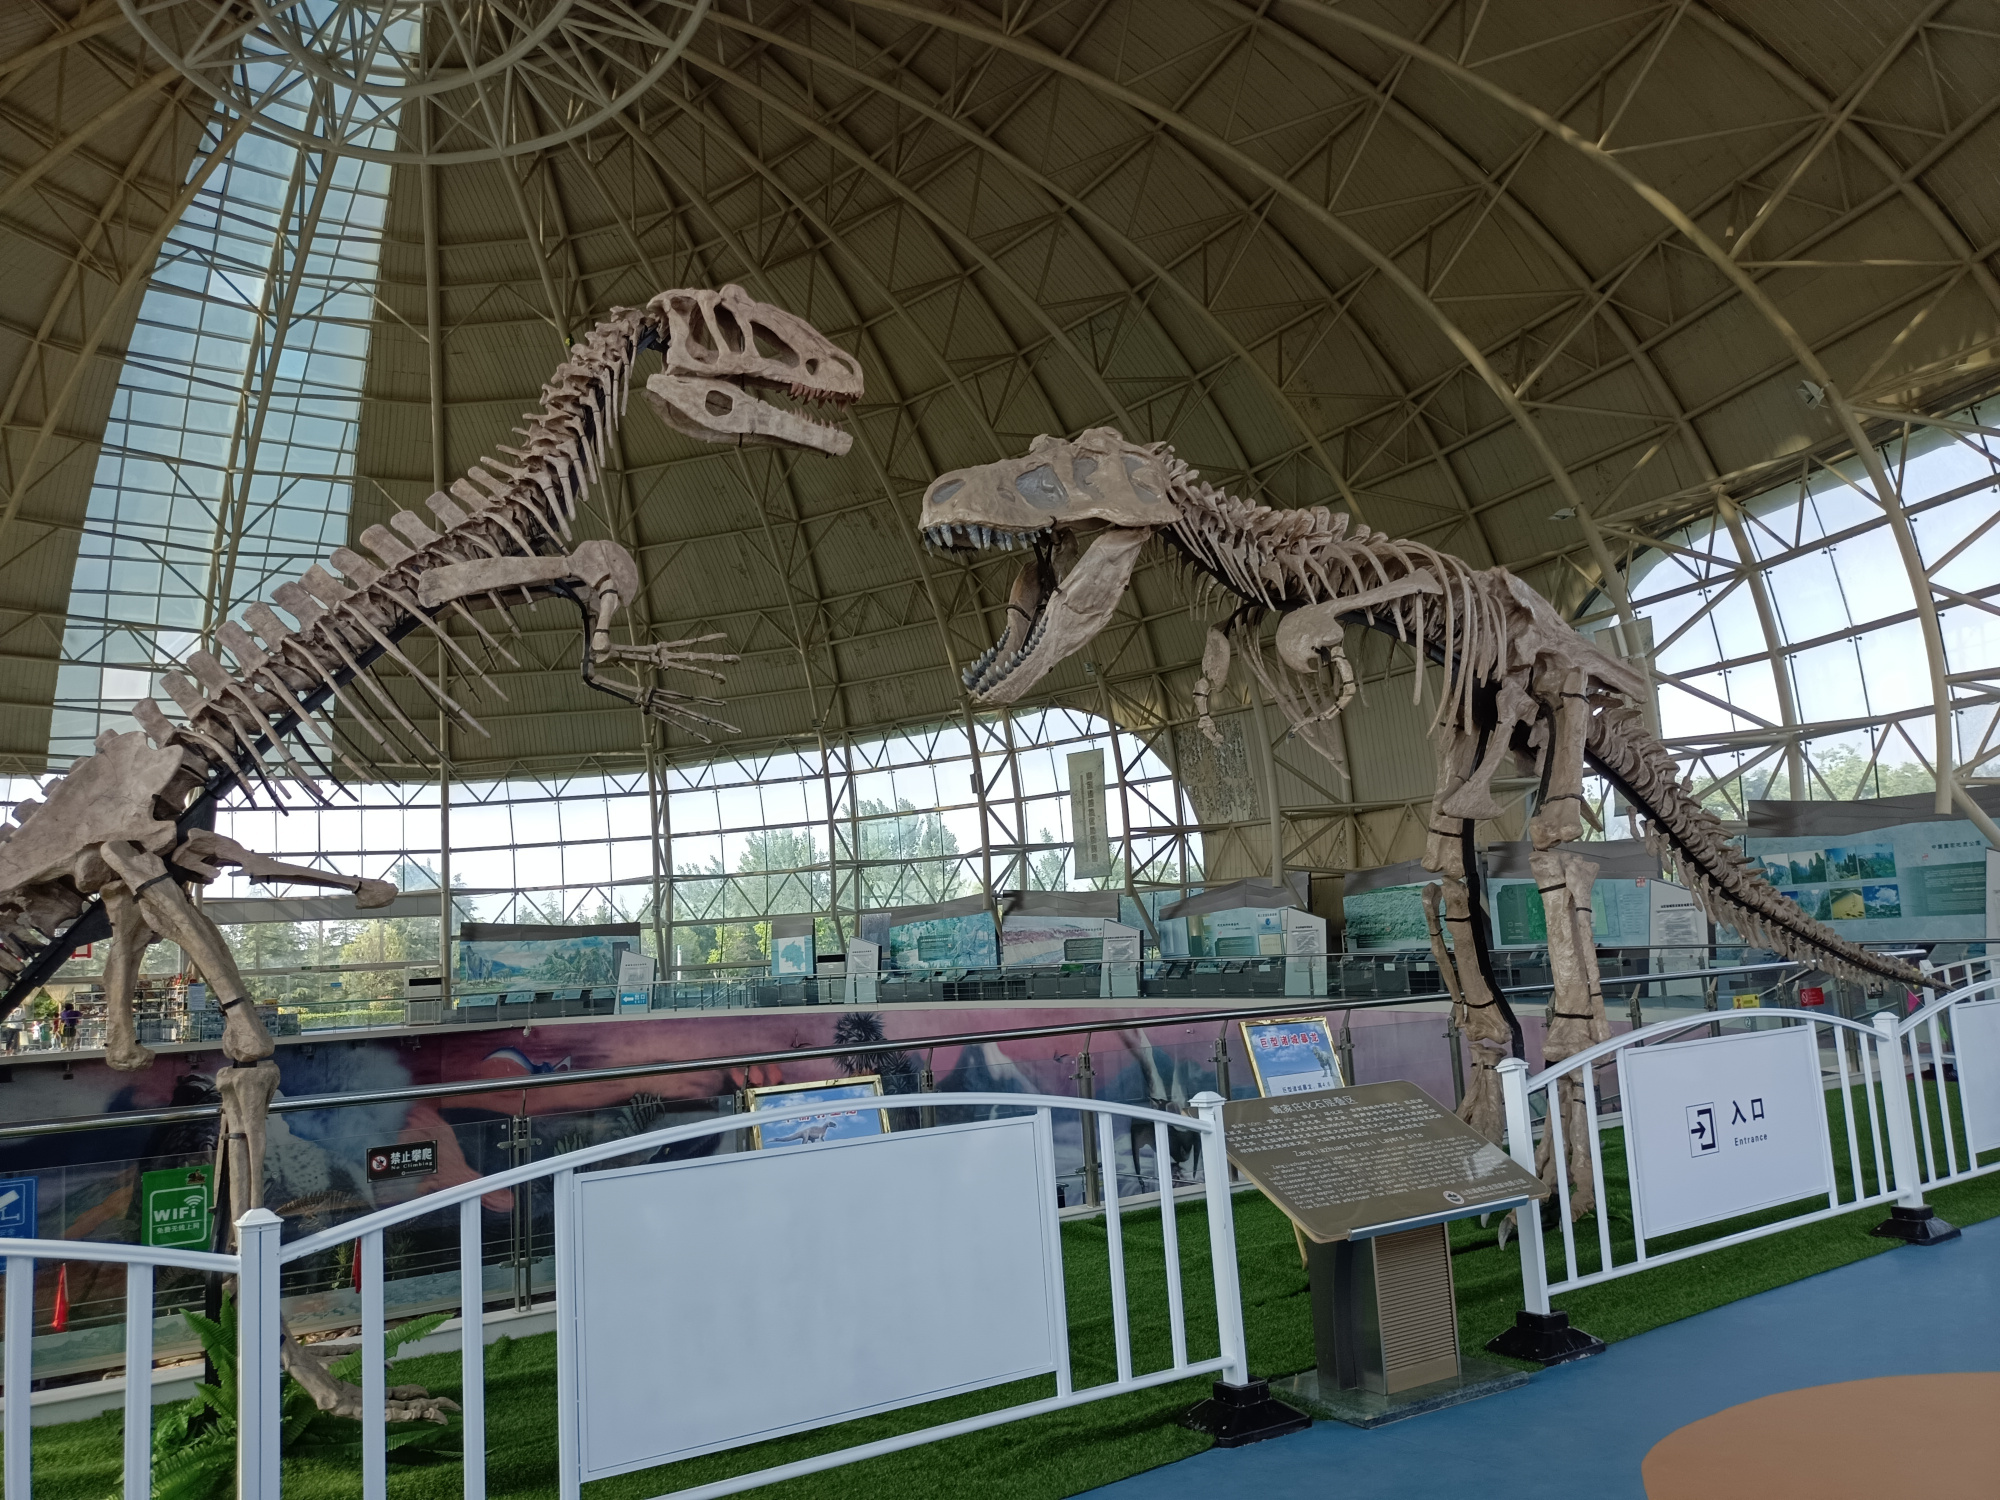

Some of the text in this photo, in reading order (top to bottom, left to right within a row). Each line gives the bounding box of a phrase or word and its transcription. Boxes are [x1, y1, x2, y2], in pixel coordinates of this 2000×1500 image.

[1260, 1032, 1319, 1048] 巨型诸城暴龙
[1731, 1098, 1765, 1125] 入口
[1734, 1133, 1768, 1146] Entrance
[390, 1148, 432, 1164] 禁止攀爬
[156, 1222, 200, 1234] 免费无线上网
